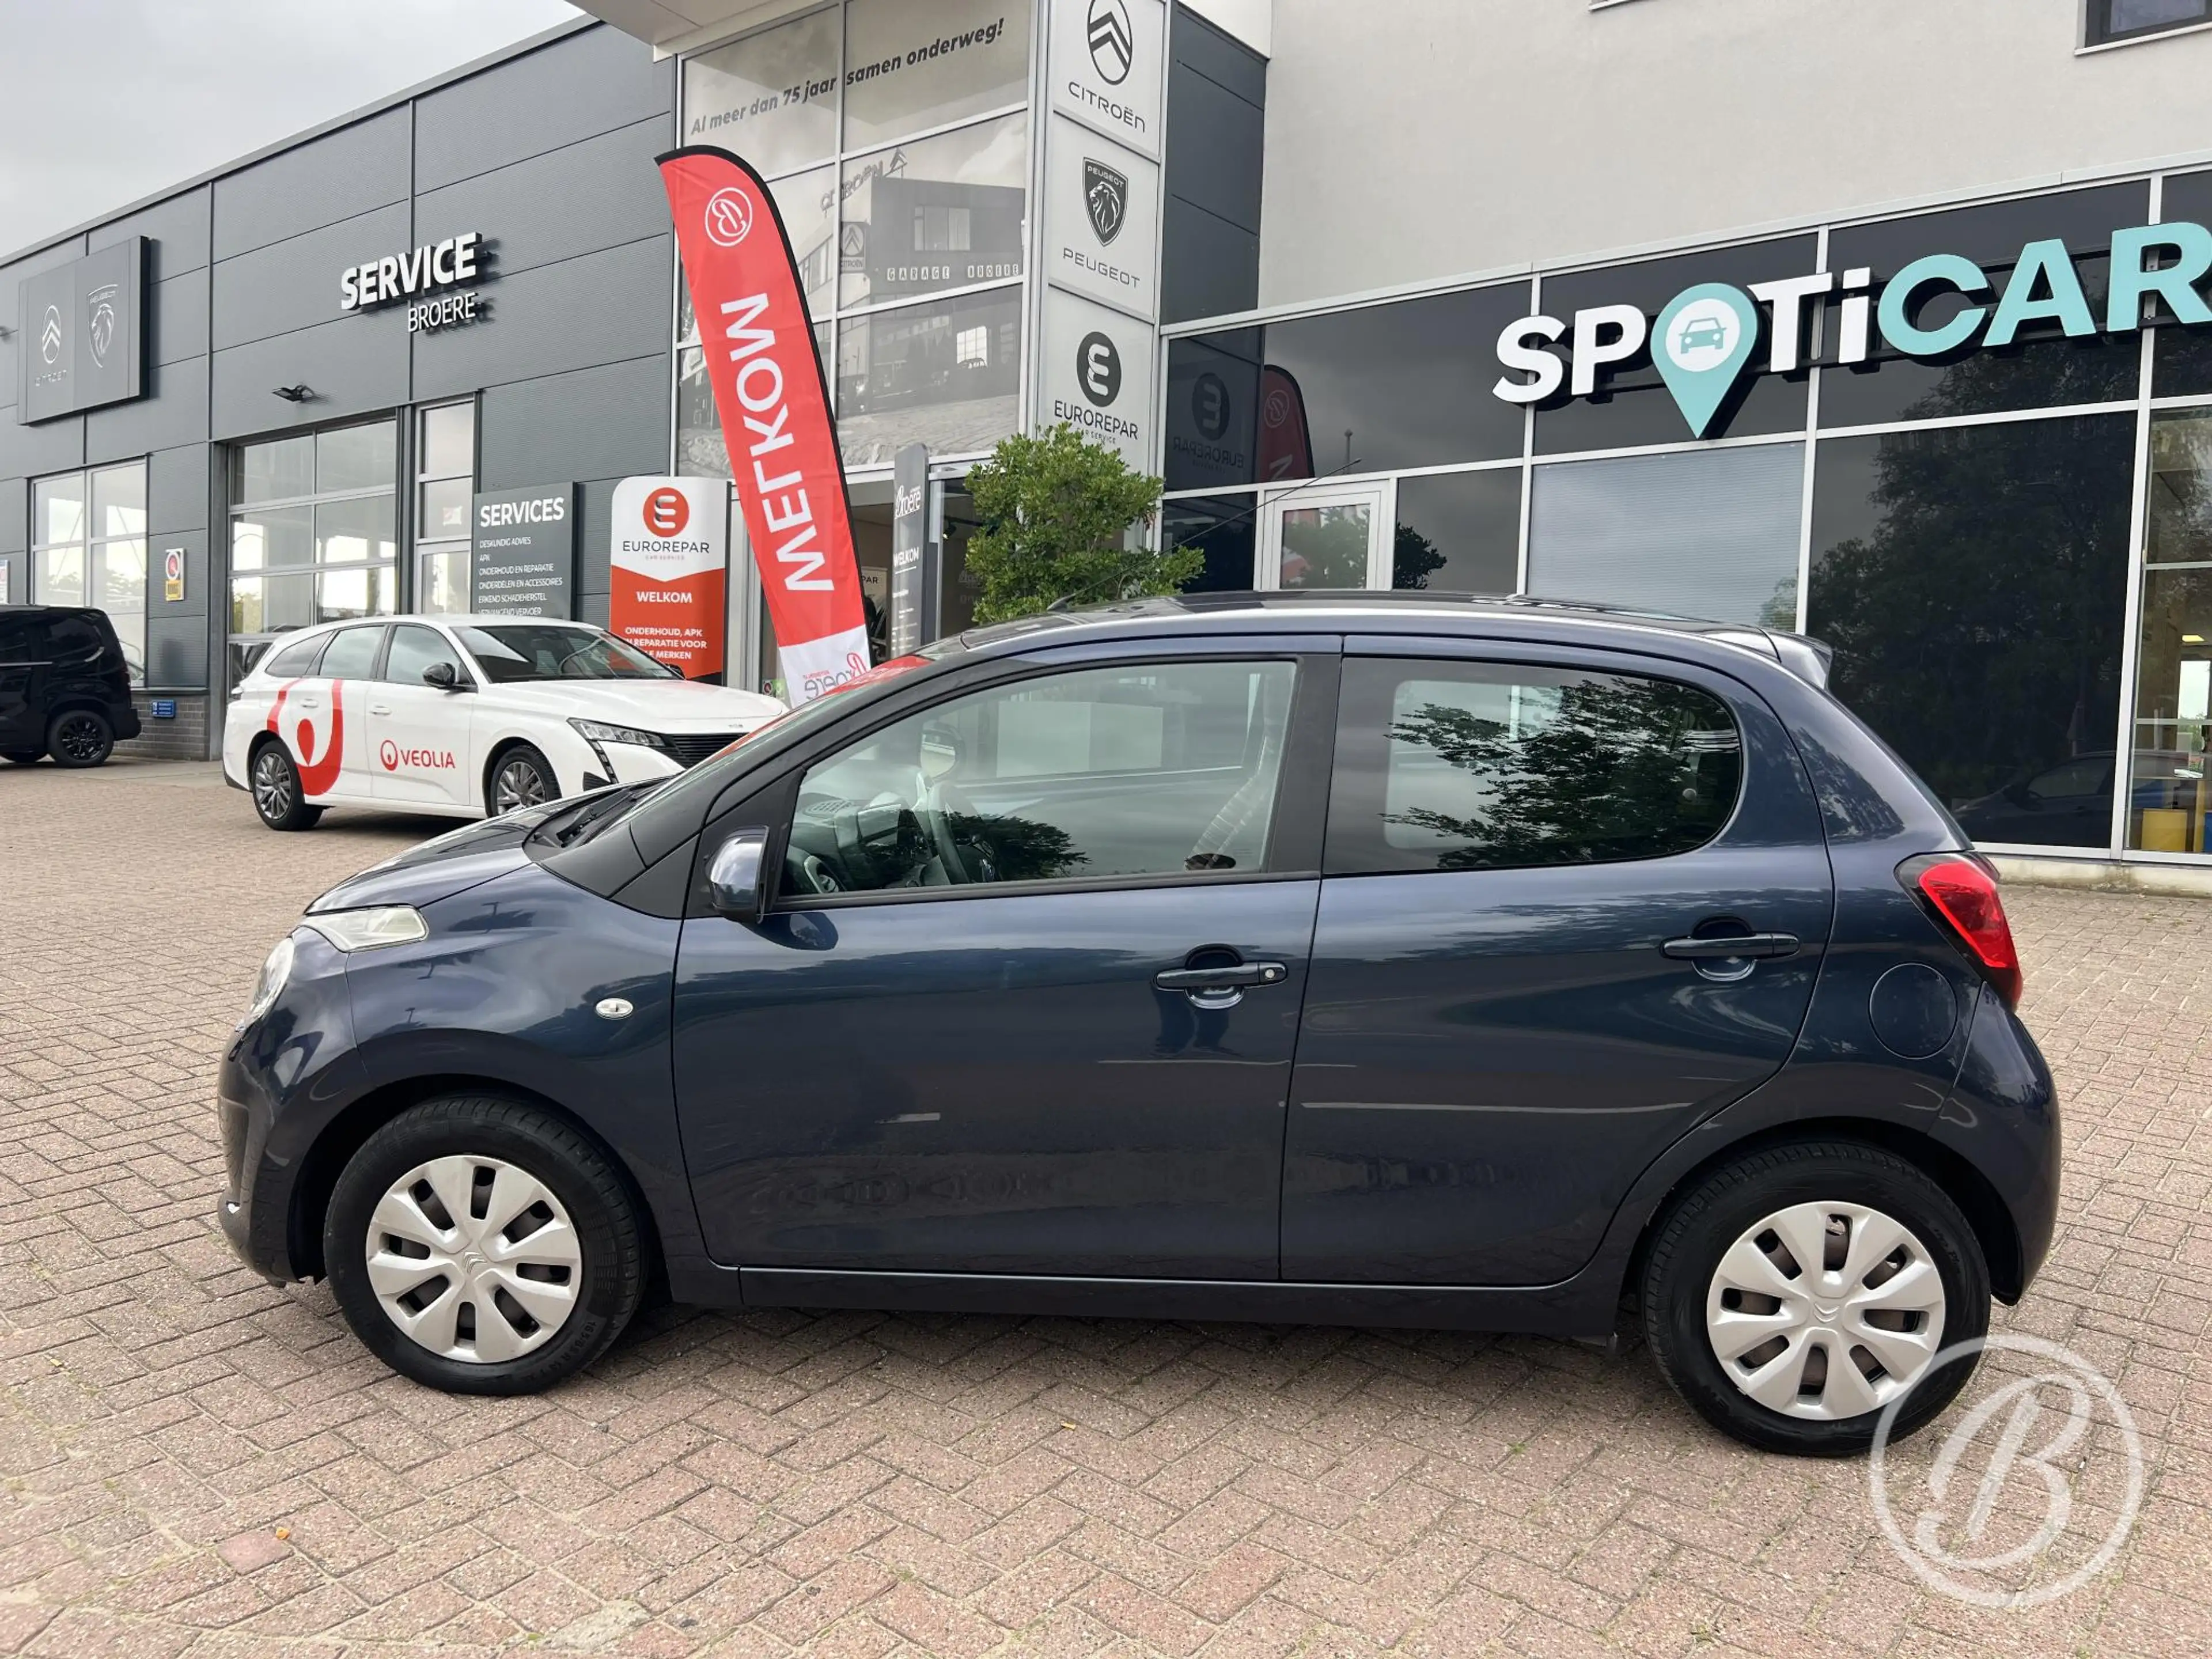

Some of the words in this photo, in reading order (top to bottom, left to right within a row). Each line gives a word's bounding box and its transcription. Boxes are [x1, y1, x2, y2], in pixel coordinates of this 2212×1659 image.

[691, 116, 706, 136] Al
[710, 106, 747, 130] meer
[750, 95, 778, 115] dan
[783, 86, 800, 105] 75
[802, 78, 837, 104] jaar
[846, 56, 902, 85] samen
[906, 18, 1005, 66] onderweg!
[1087, 165, 1125, 188] PEUGEOT
[341, 232, 482, 310] SERVICE
[887, 266, 950, 281] GARAGE
[1063, 248, 1140, 288] PEUGEOT
[408, 292, 476, 332] BROERE
[1054, 399, 1139, 441] EUROREPAR
[480, 497, 565, 528] SERVICES
[623, 540, 710, 554] EUROREPAR
[479, 554, 490, 562] APK
[893, 547, 919, 567] WELKOM
[479, 565, 514, 575] ONDERHOUD
[516, 564, 522, 574] EN
[524, 563, 554, 573] REPARATIE
[516, 579, 524, 588] EN
[525, 577, 563, 586] ACCESSOIRES
[636, 591, 692, 603] WELKOM
[625, 627, 683, 638] ONDERHOUD,
[684, 628, 703, 637] APK
[633, 638, 678, 647] REPARATIE
[680, 640, 707, 649] VOOR
[656, 652, 691, 660] MERKEN
[400, 749, 456, 768] VEOLIA
